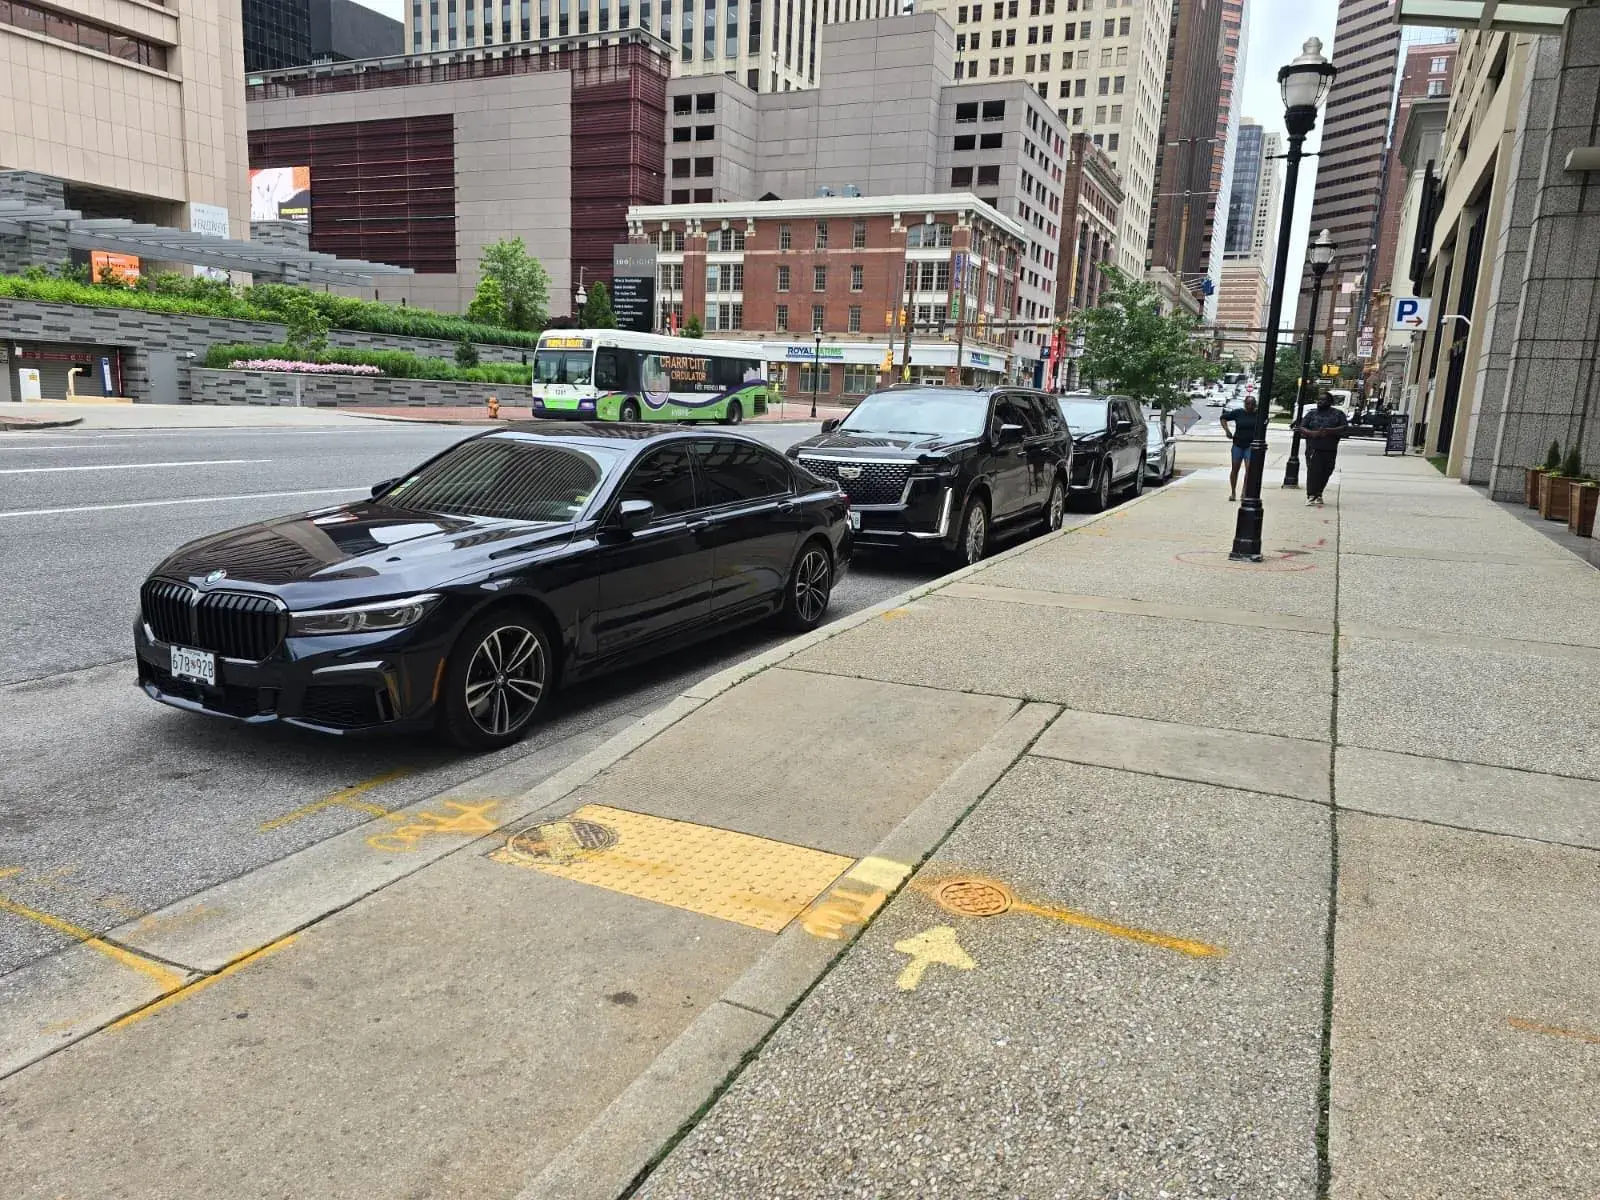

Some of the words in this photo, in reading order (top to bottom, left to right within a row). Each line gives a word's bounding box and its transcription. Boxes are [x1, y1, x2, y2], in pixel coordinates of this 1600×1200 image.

[1397, 300, 1418, 322] P
[787, 346, 814, 355] ROYAL
[660, 356, 687, 369] CHARM
[688, 357, 706, 370] CITY
[671, 370, 707, 381] CIRCULATOR
